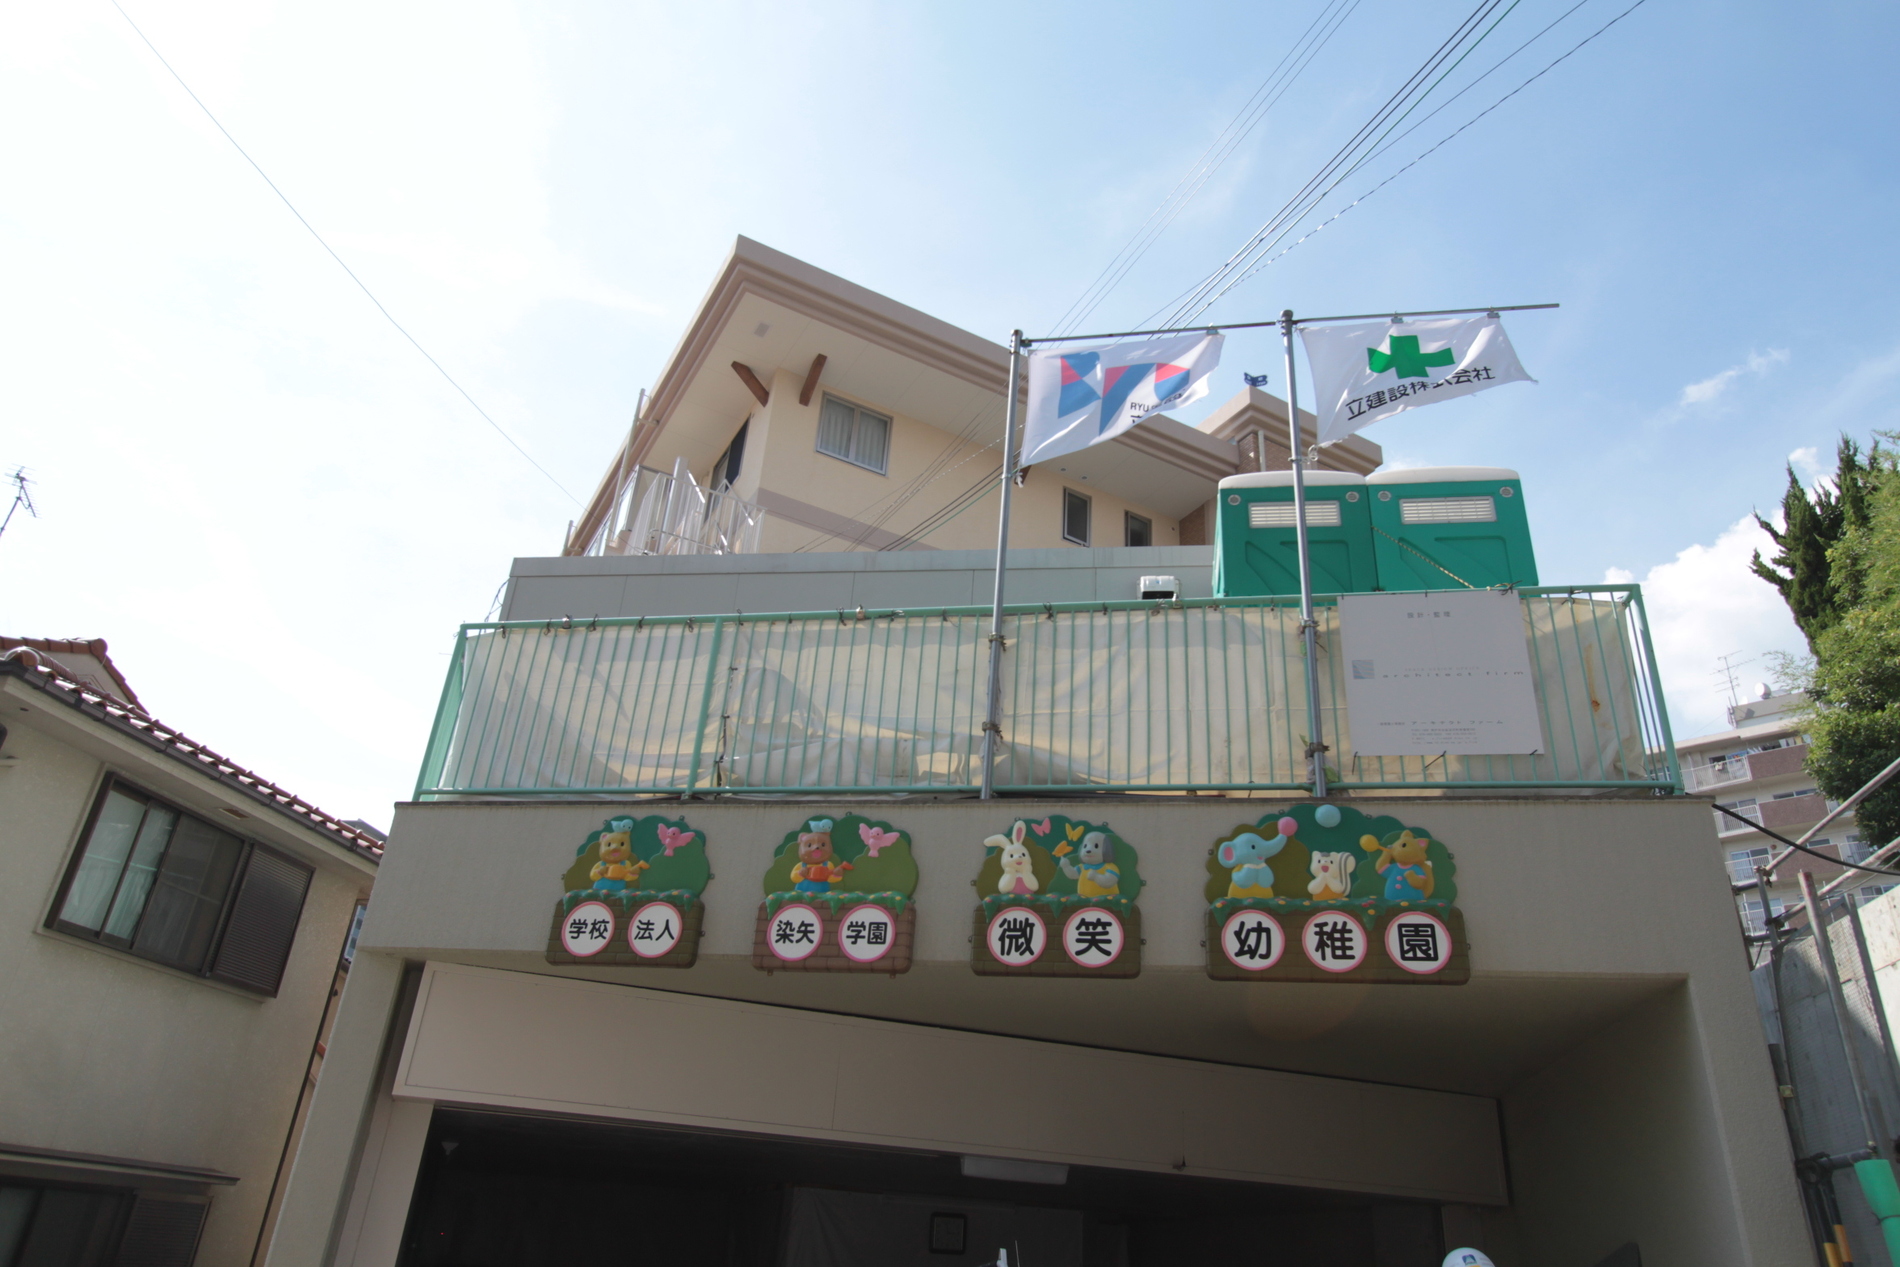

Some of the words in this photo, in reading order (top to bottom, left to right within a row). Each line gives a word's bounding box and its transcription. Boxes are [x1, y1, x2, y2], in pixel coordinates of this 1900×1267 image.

[1382, 671, 1473, 679] architect
[568, 918, 676, 942] 学校法人
[774, 919, 888, 945] 染矢学園
[998, 917, 1113, 957] 微笑
[1234, 919, 1439, 963] 幼稚園
